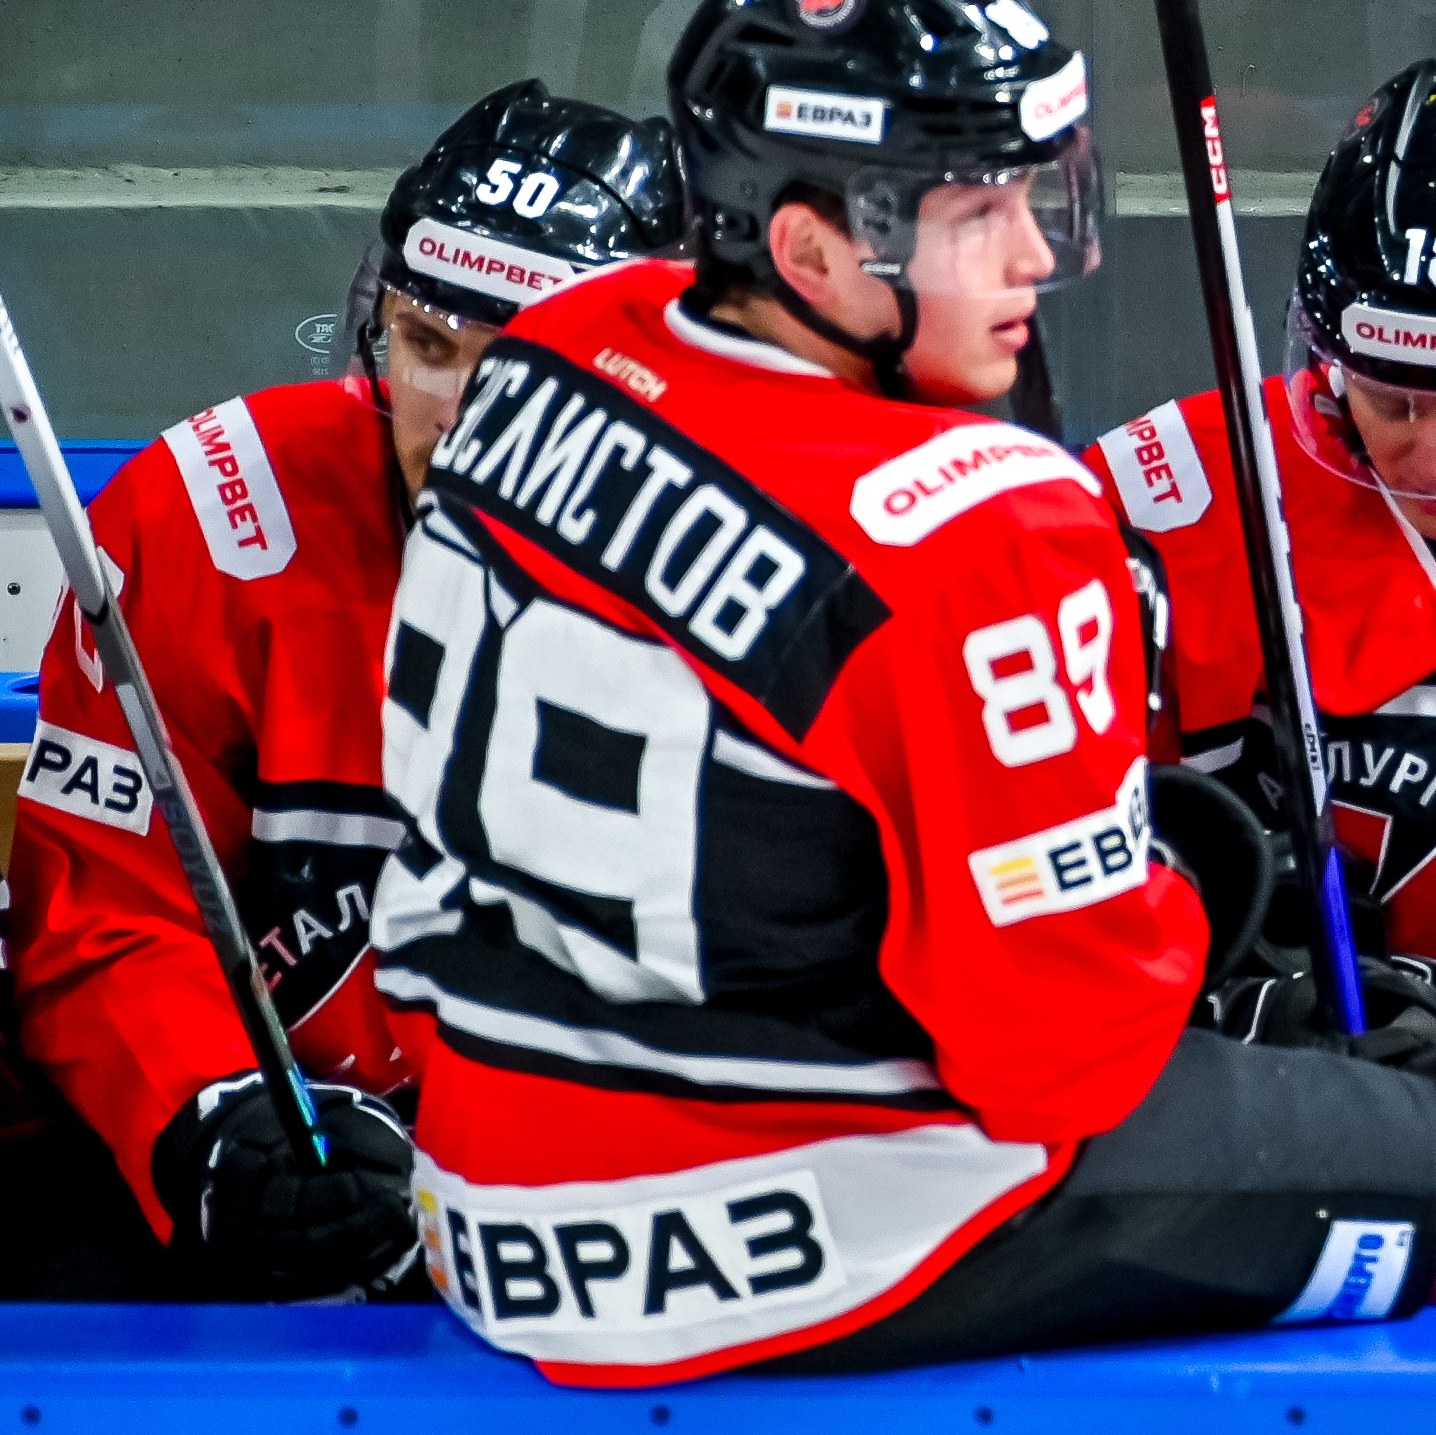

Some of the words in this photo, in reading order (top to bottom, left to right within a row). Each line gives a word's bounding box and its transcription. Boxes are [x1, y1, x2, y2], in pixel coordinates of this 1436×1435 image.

[476, 157, 560, 219] 50
[1200, 106, 1229, 195] CCM
[963, 578, 1115, 768] 89
[25, 739, 145, 816] РАЗ
[446, 1189, 828, 1322] ЕВРАЗ
